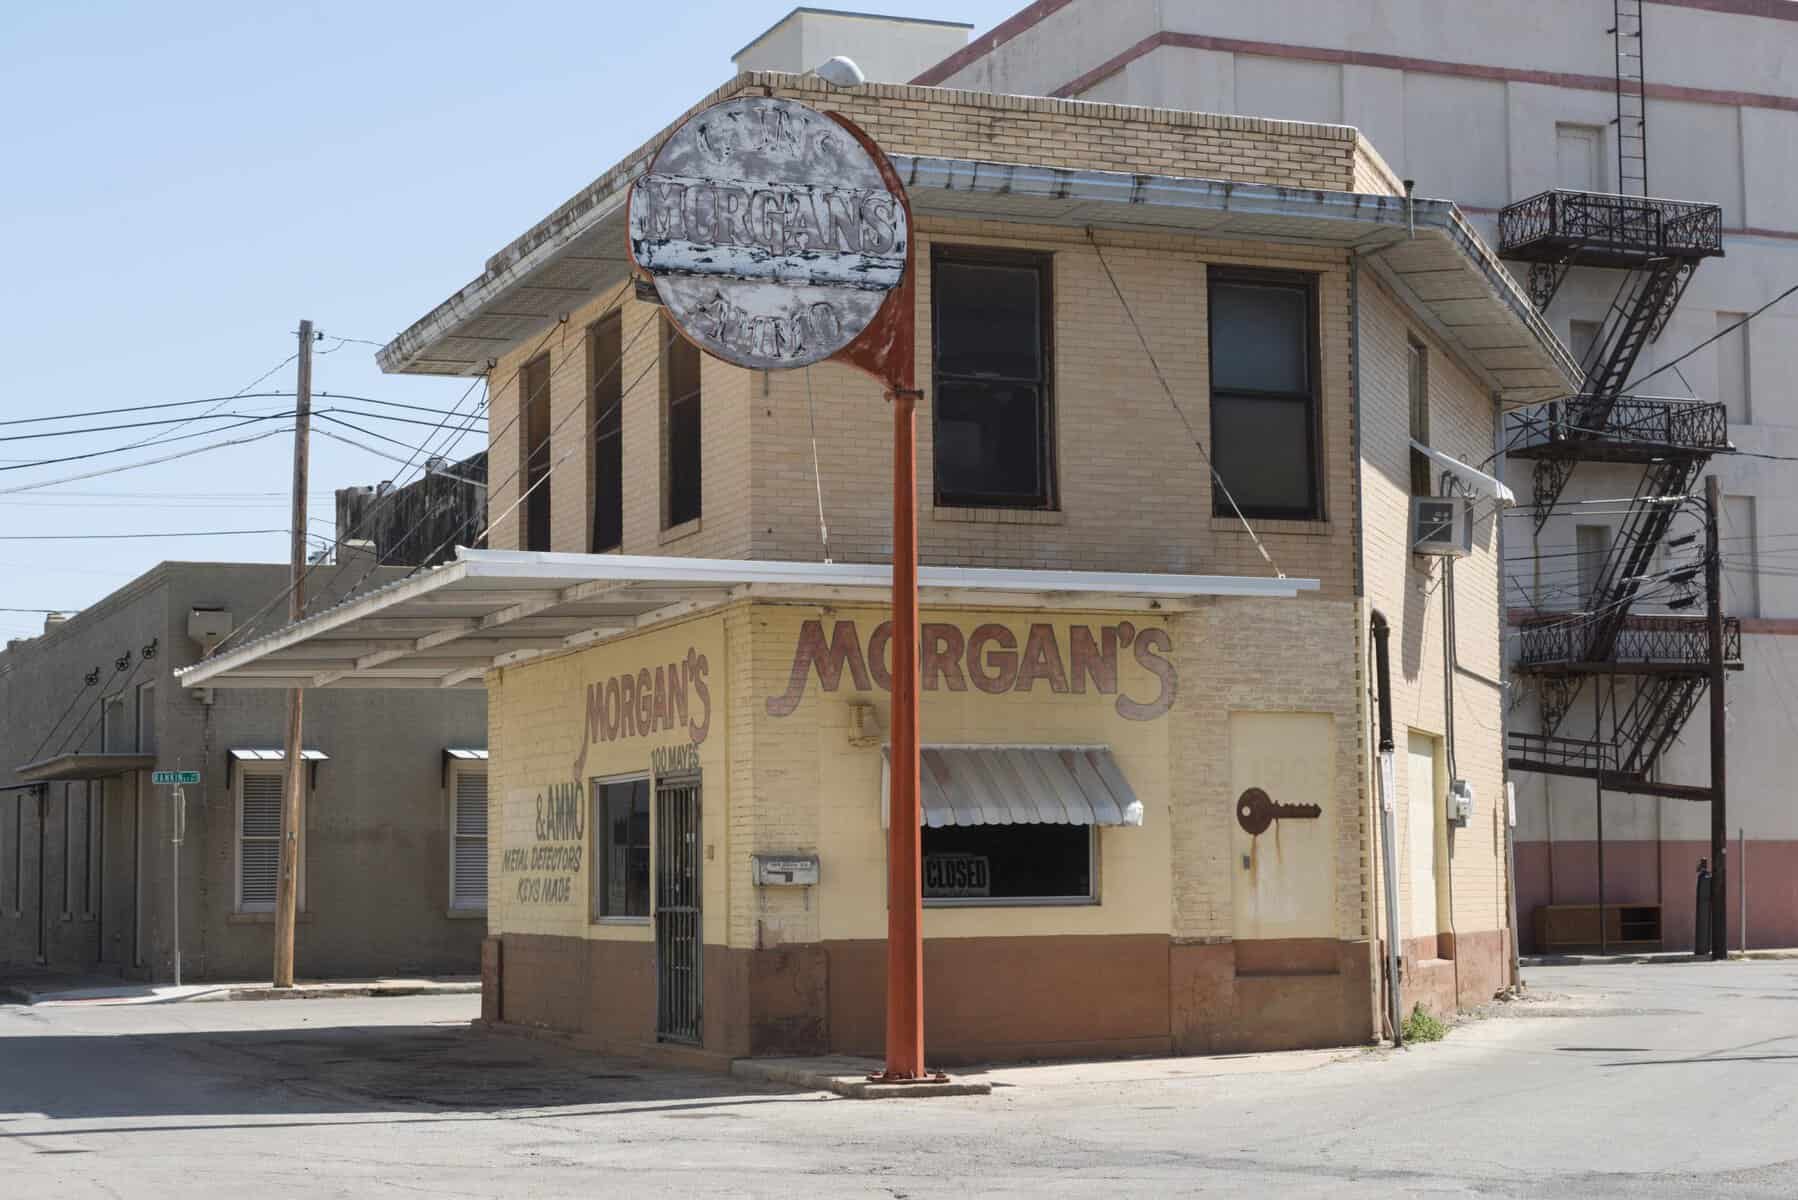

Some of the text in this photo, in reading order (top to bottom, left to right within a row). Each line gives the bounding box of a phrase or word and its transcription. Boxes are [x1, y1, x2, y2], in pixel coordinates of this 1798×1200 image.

[574, 647, 711, 780] MORGAN'S
[536, 784, 584, 841] & AMMO
[503, 846, 582, 872] METAL DETECTORS
[926, 860, 986, 889] CLOSED
[517, 878, 571, 904] KEYS MADE
